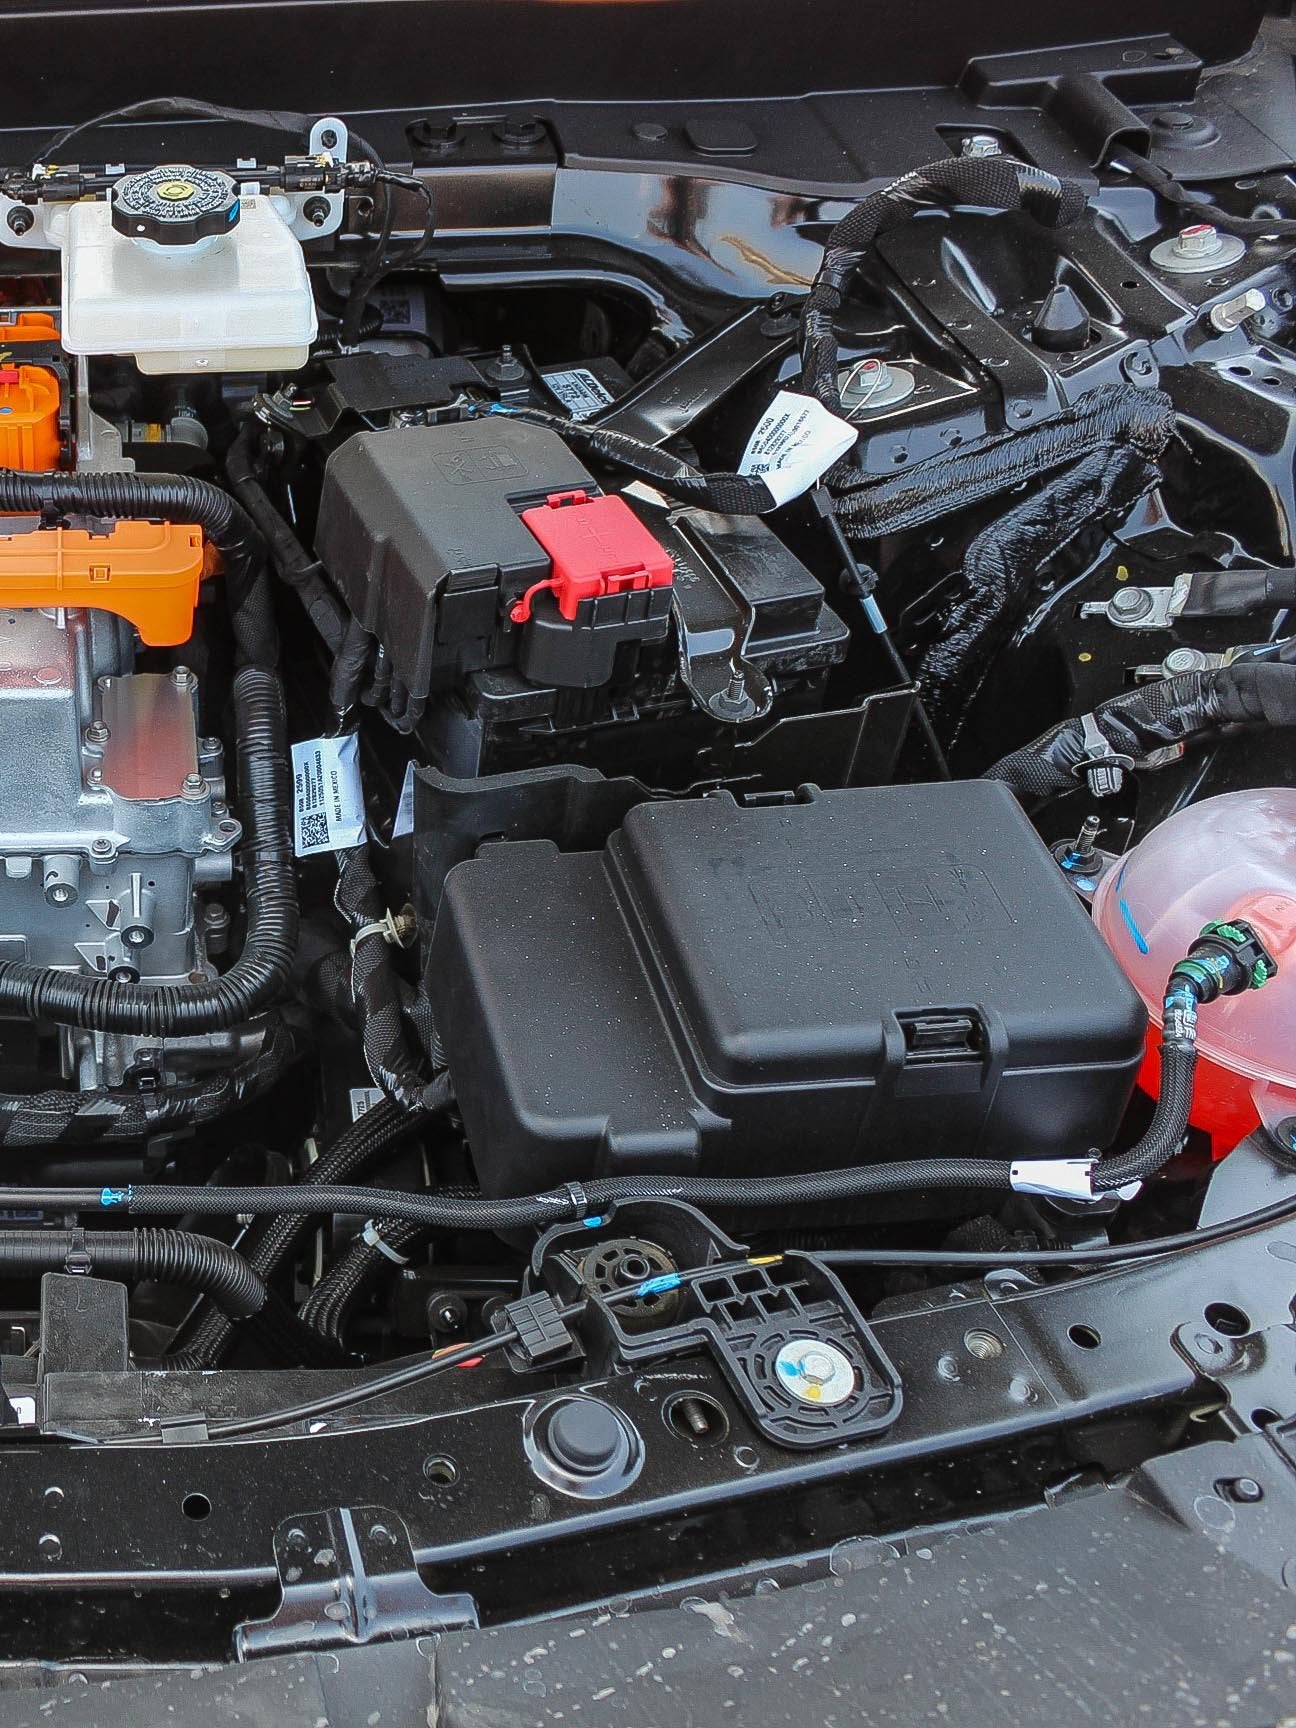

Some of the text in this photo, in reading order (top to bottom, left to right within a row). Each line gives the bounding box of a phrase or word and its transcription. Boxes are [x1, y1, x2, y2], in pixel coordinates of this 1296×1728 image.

[330, 770, 343, 822] MADE IN MEXICO
